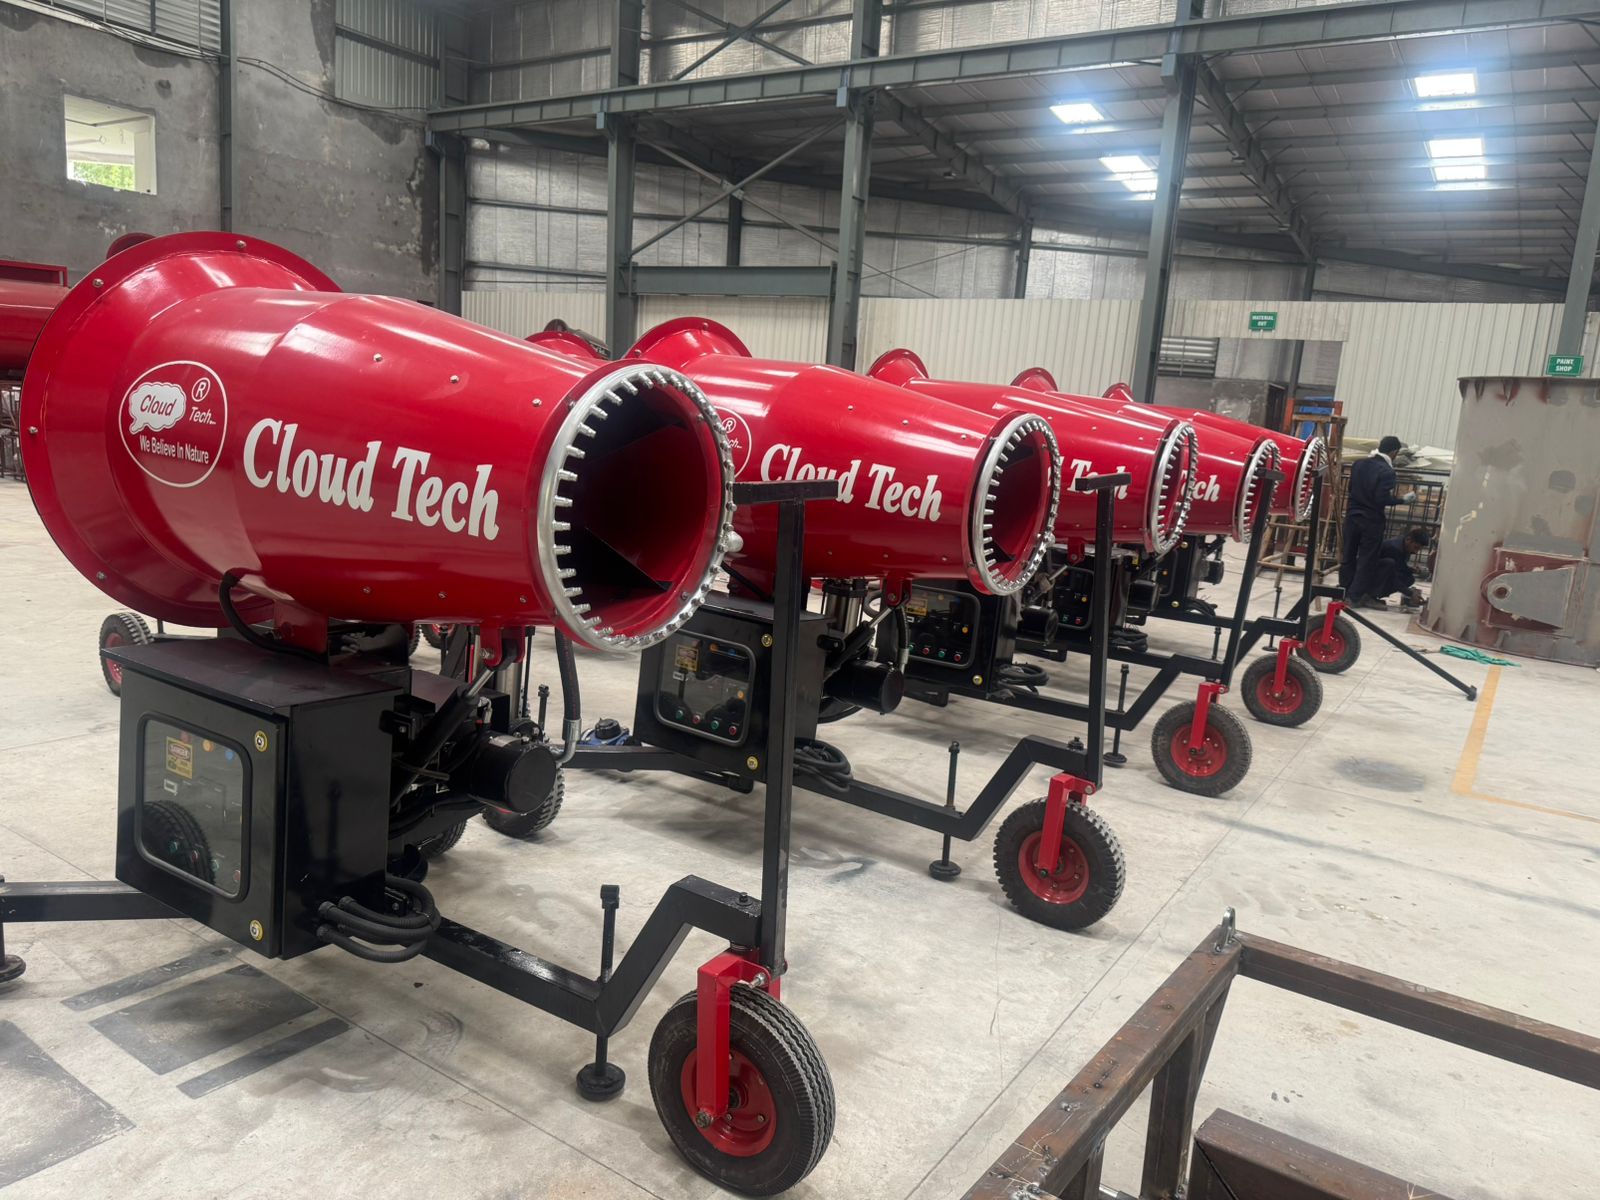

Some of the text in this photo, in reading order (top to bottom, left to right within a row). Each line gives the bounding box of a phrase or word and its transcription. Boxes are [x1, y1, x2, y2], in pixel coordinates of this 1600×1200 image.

[140, 394, 177, 417] Cloud
[140, 435, 209, 464] We Believe In Nature
[243, 418, 500, 541] Cloud Tech
[864, 463, 943, 522] Tech
[1066, 458, 1128, 500] Th
